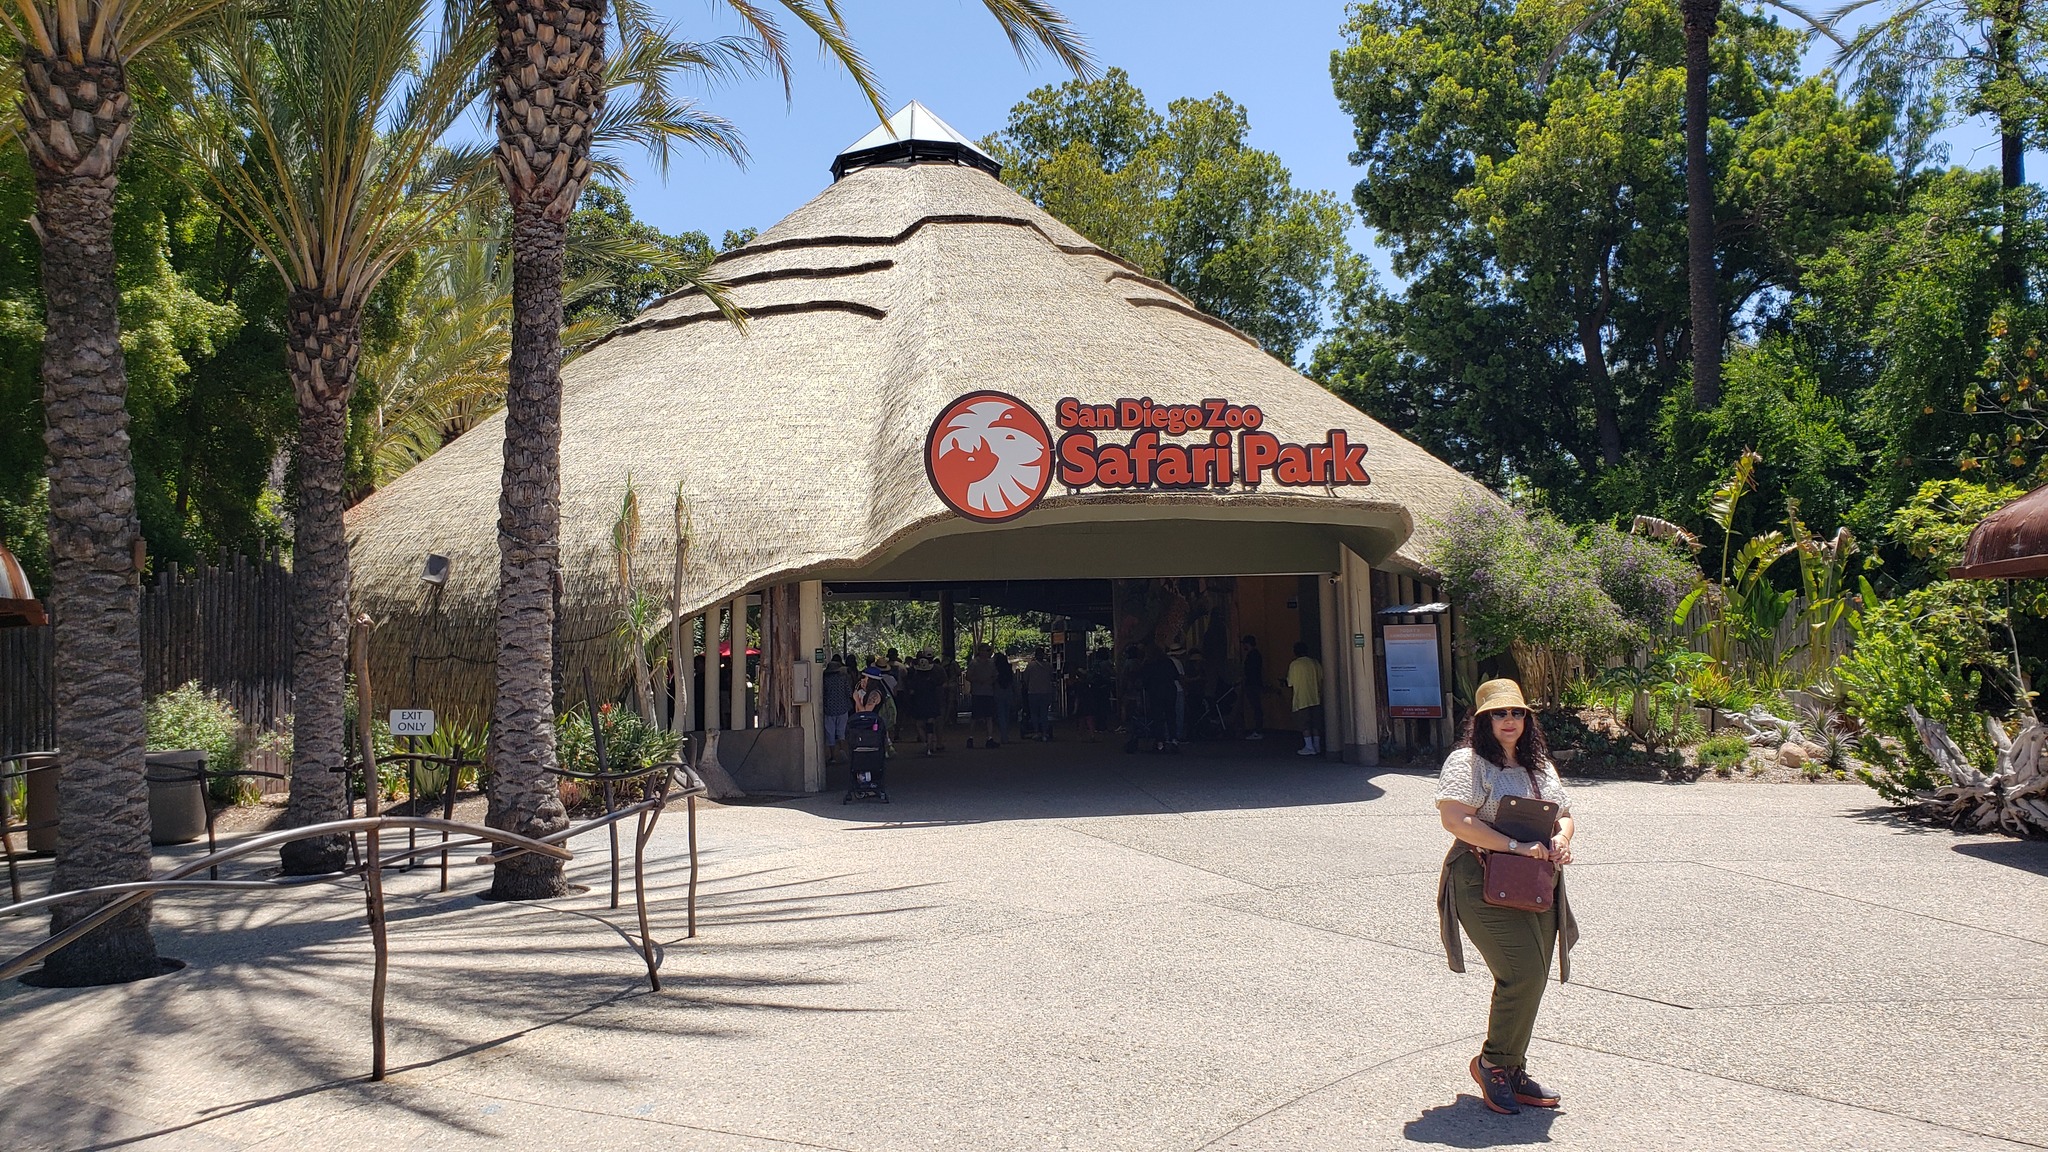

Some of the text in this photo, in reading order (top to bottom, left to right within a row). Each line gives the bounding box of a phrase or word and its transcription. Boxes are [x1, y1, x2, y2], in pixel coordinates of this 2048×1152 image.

[1059, 399, 1262, 435] San Diego Zoo
[1060, 430, 1368, 486] Safari Park
[397, 722, 427, 731] ONLY
[401, 711, 423, 720] EXIT
